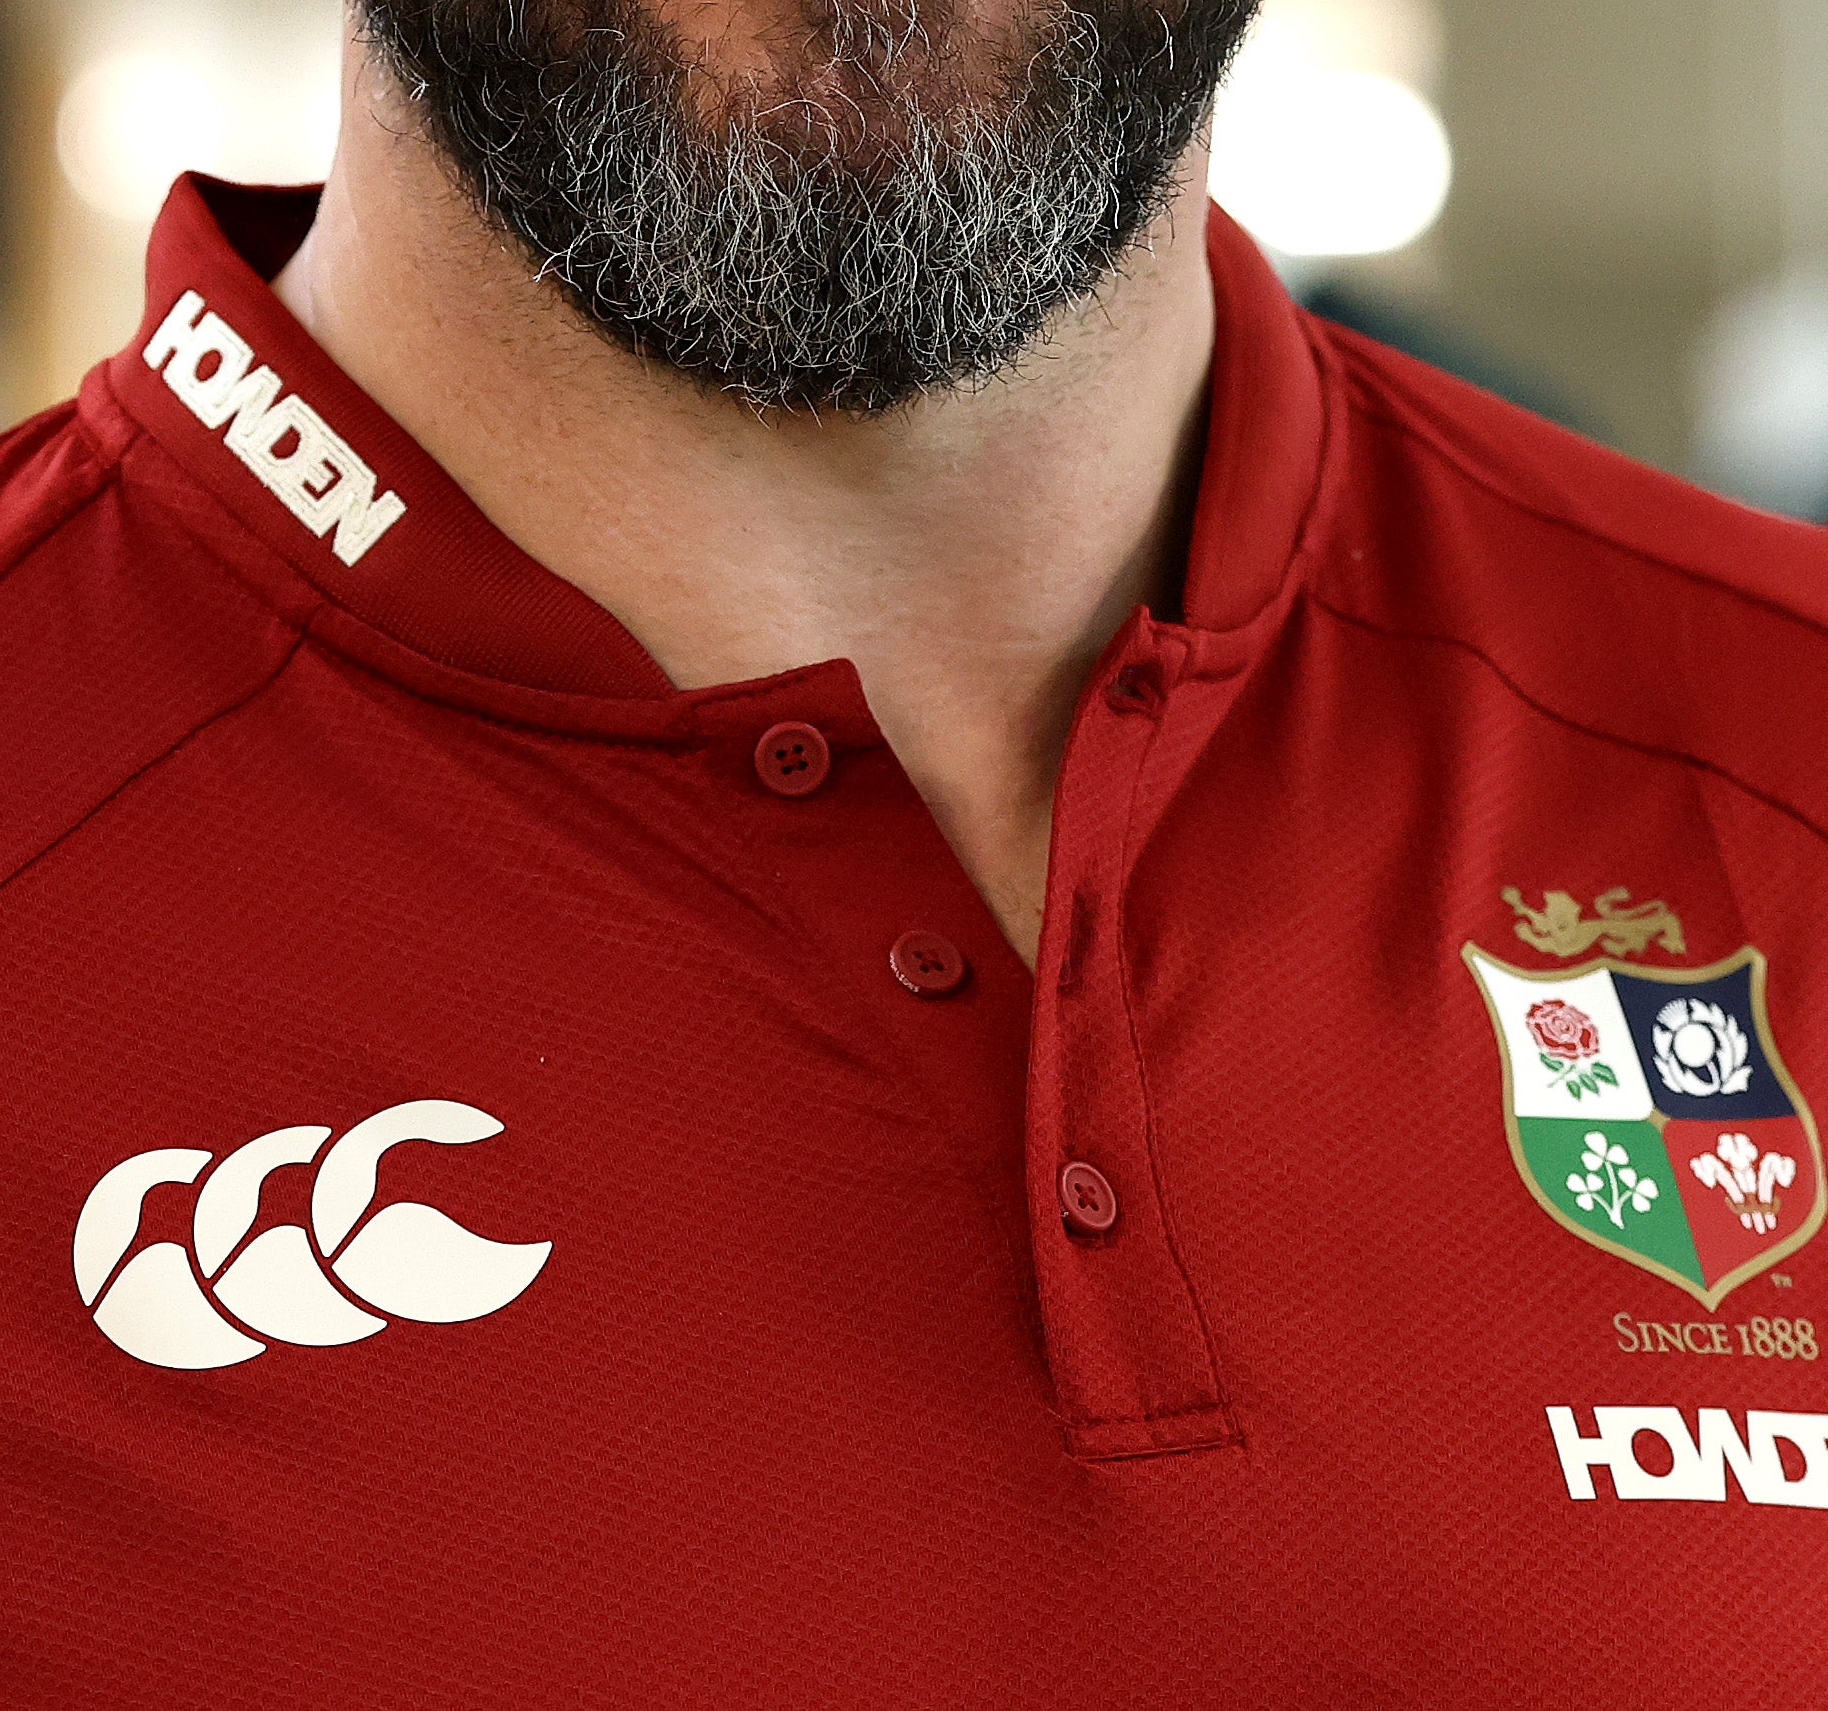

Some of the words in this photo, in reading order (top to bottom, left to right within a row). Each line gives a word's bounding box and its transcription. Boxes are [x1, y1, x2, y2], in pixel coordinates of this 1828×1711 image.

[142, 289, 408, 568] HOWDEN
[1612, 1311, 1734, 1355] SINCE
[1735, 1315, 1820, 1361] 1888
